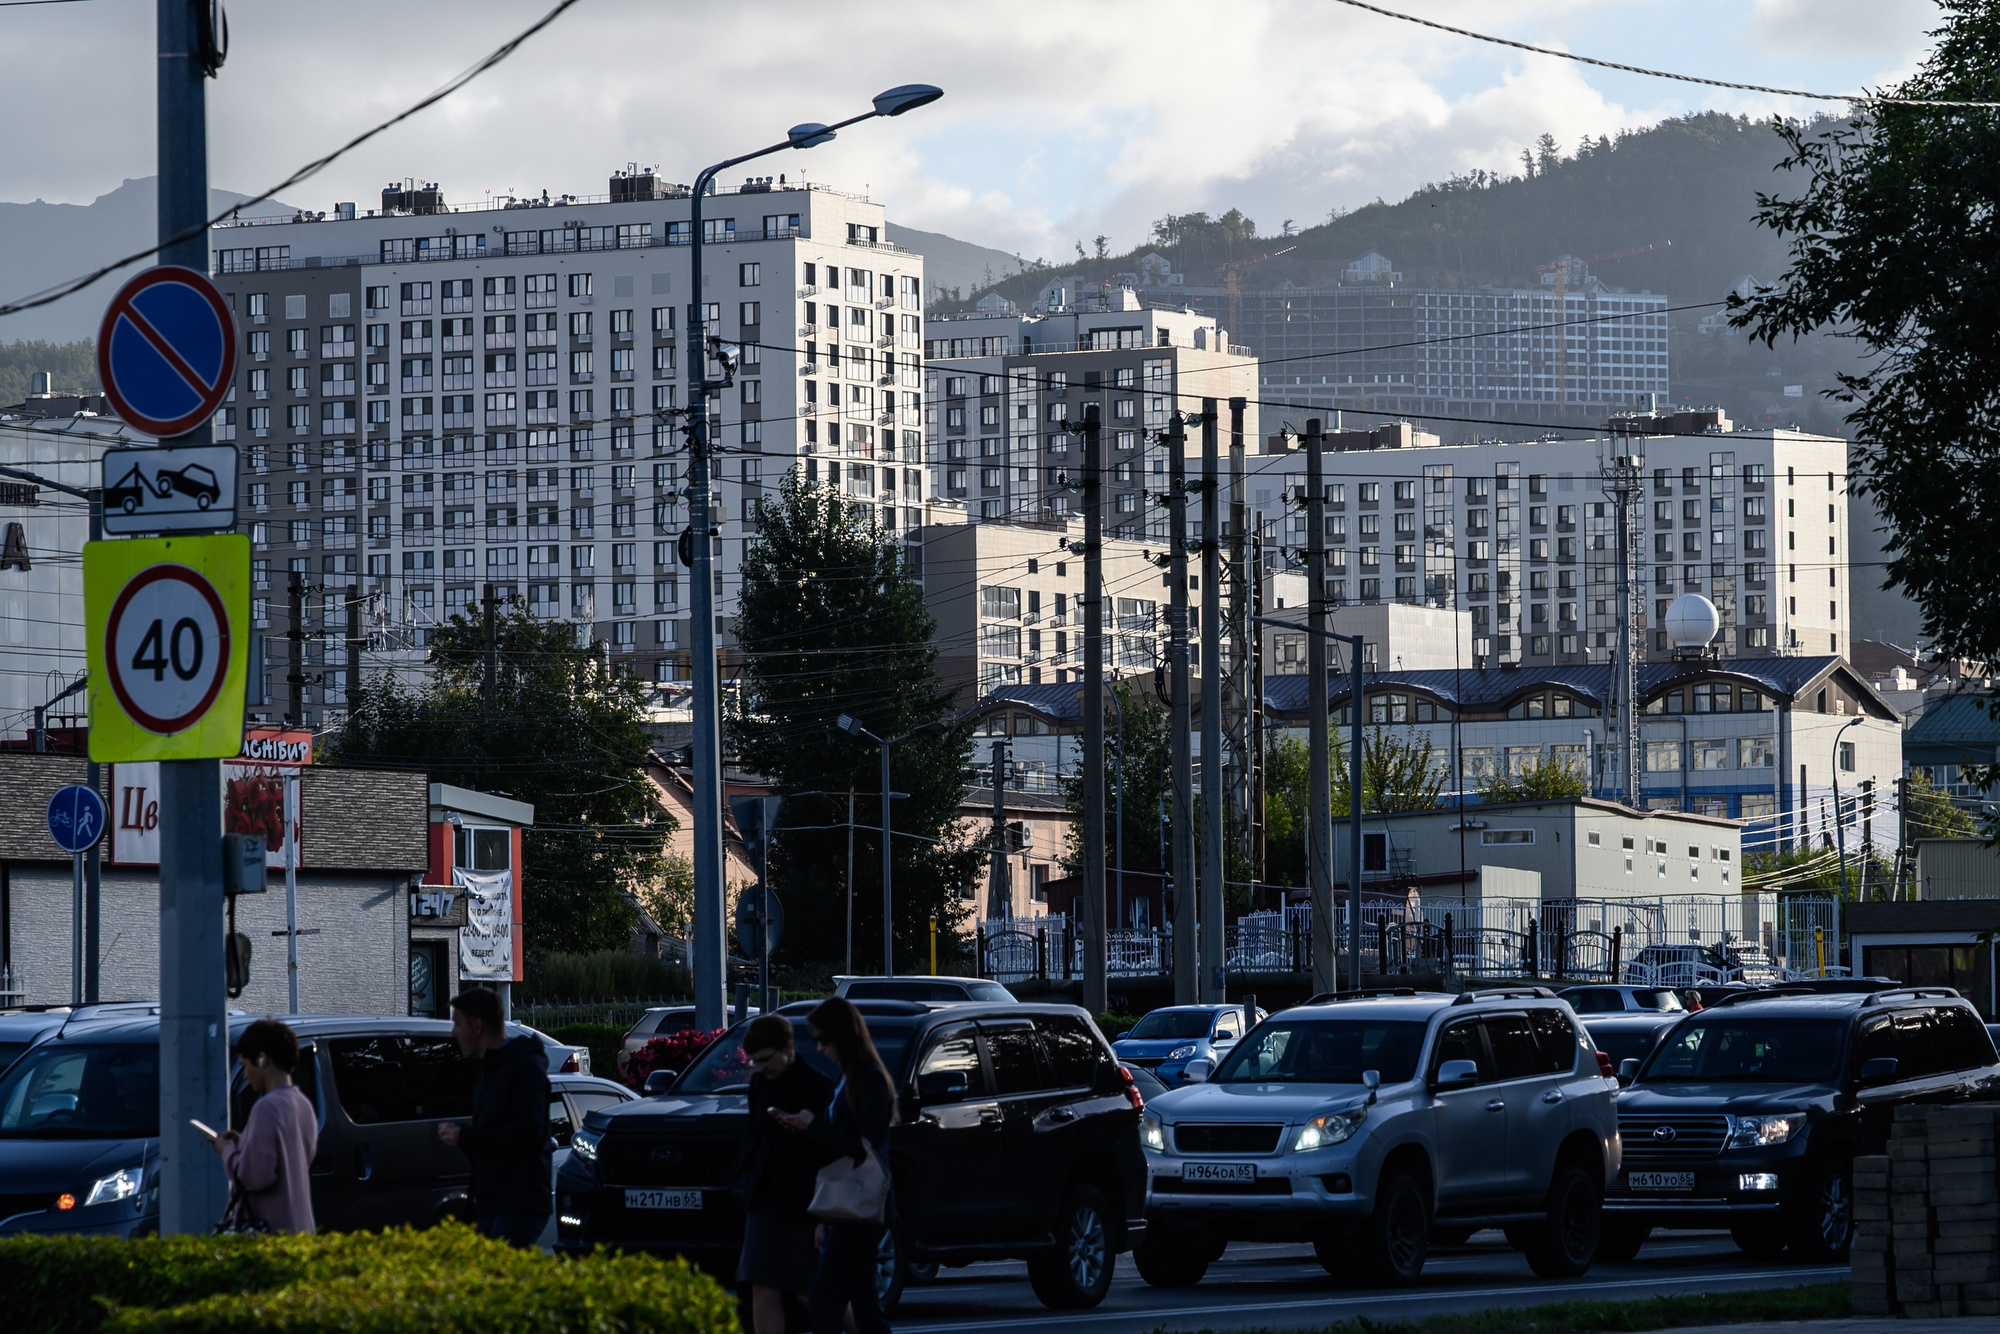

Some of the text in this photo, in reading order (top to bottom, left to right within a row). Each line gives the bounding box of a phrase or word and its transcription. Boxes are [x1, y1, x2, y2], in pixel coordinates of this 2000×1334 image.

[0, 481, 40, 507] ПЛЕКС
[131, 616, 204, 682] 40
[120, 786, 159, 837] Цв
[418, 890, 455, 918] 24/7
[1188, 1165, 1250, 1179] Н964ОА 65
[1632, 1173, 1691, 1186] М610УО 65
[630, 1192, 697, 1207] Н217НВ 65
